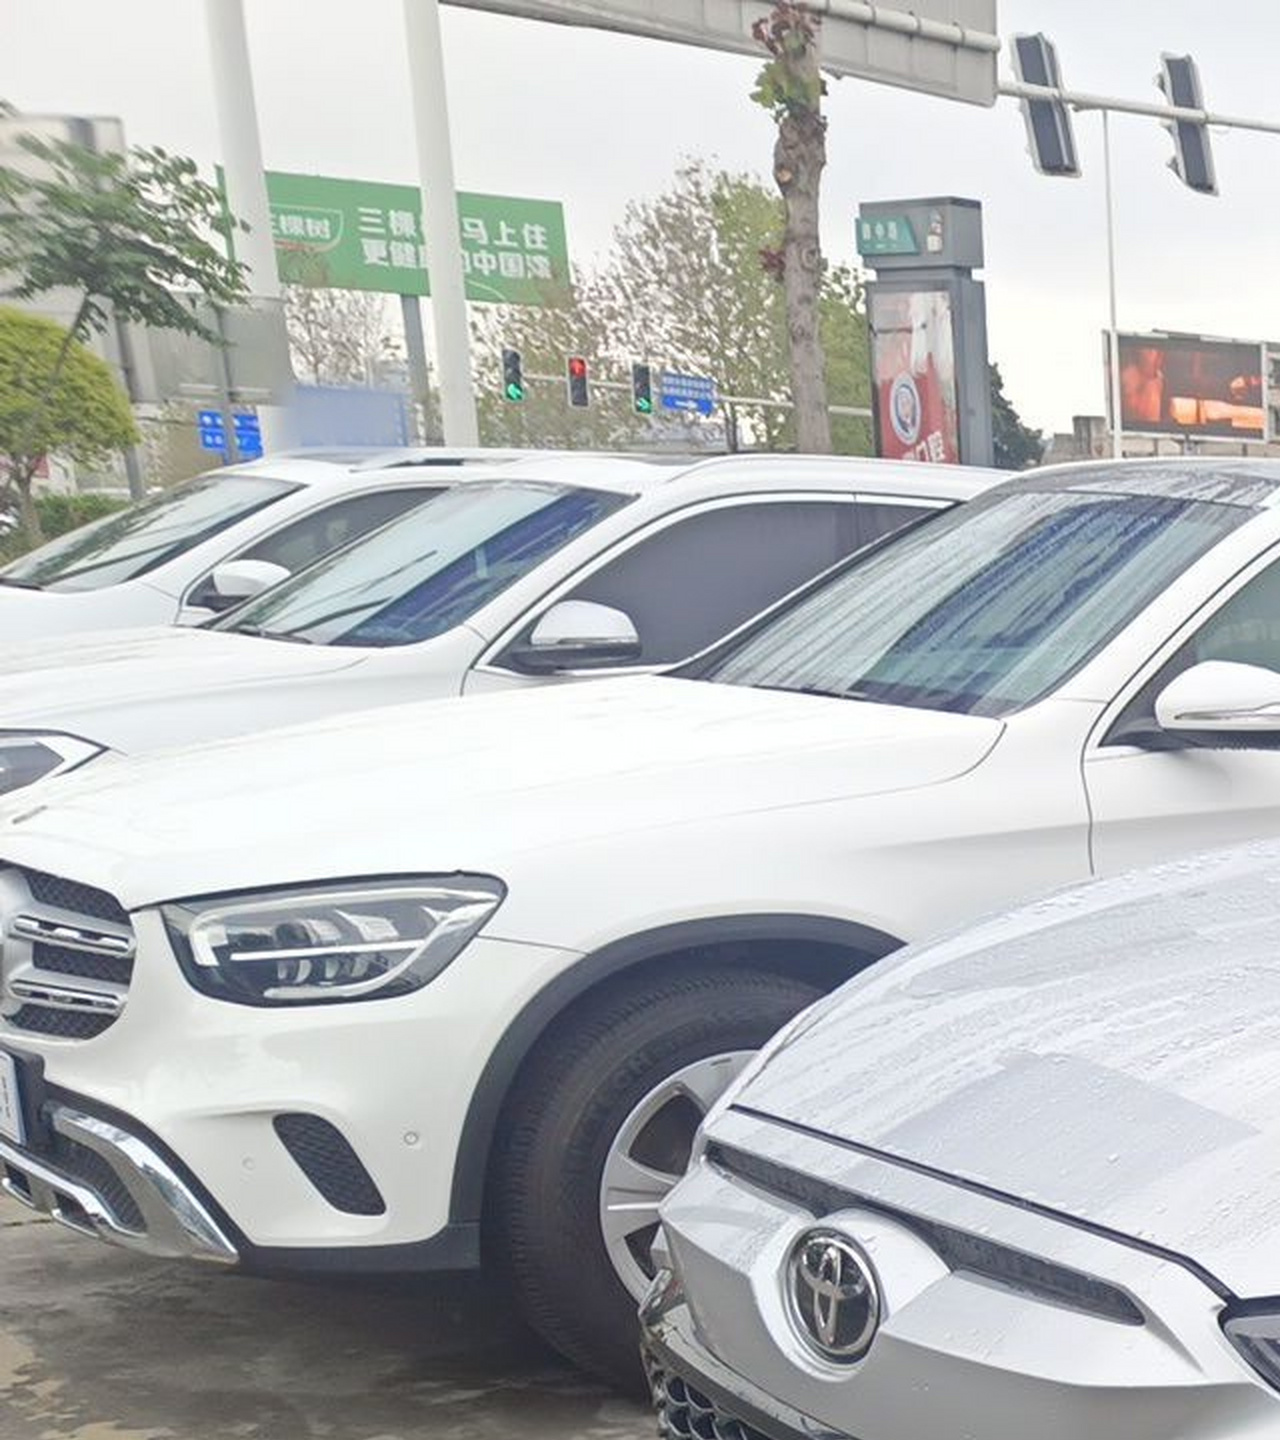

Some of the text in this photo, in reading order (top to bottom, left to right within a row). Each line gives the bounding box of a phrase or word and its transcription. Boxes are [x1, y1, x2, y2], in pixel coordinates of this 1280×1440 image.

[358, 207, 548, 250] 三棵马上住
